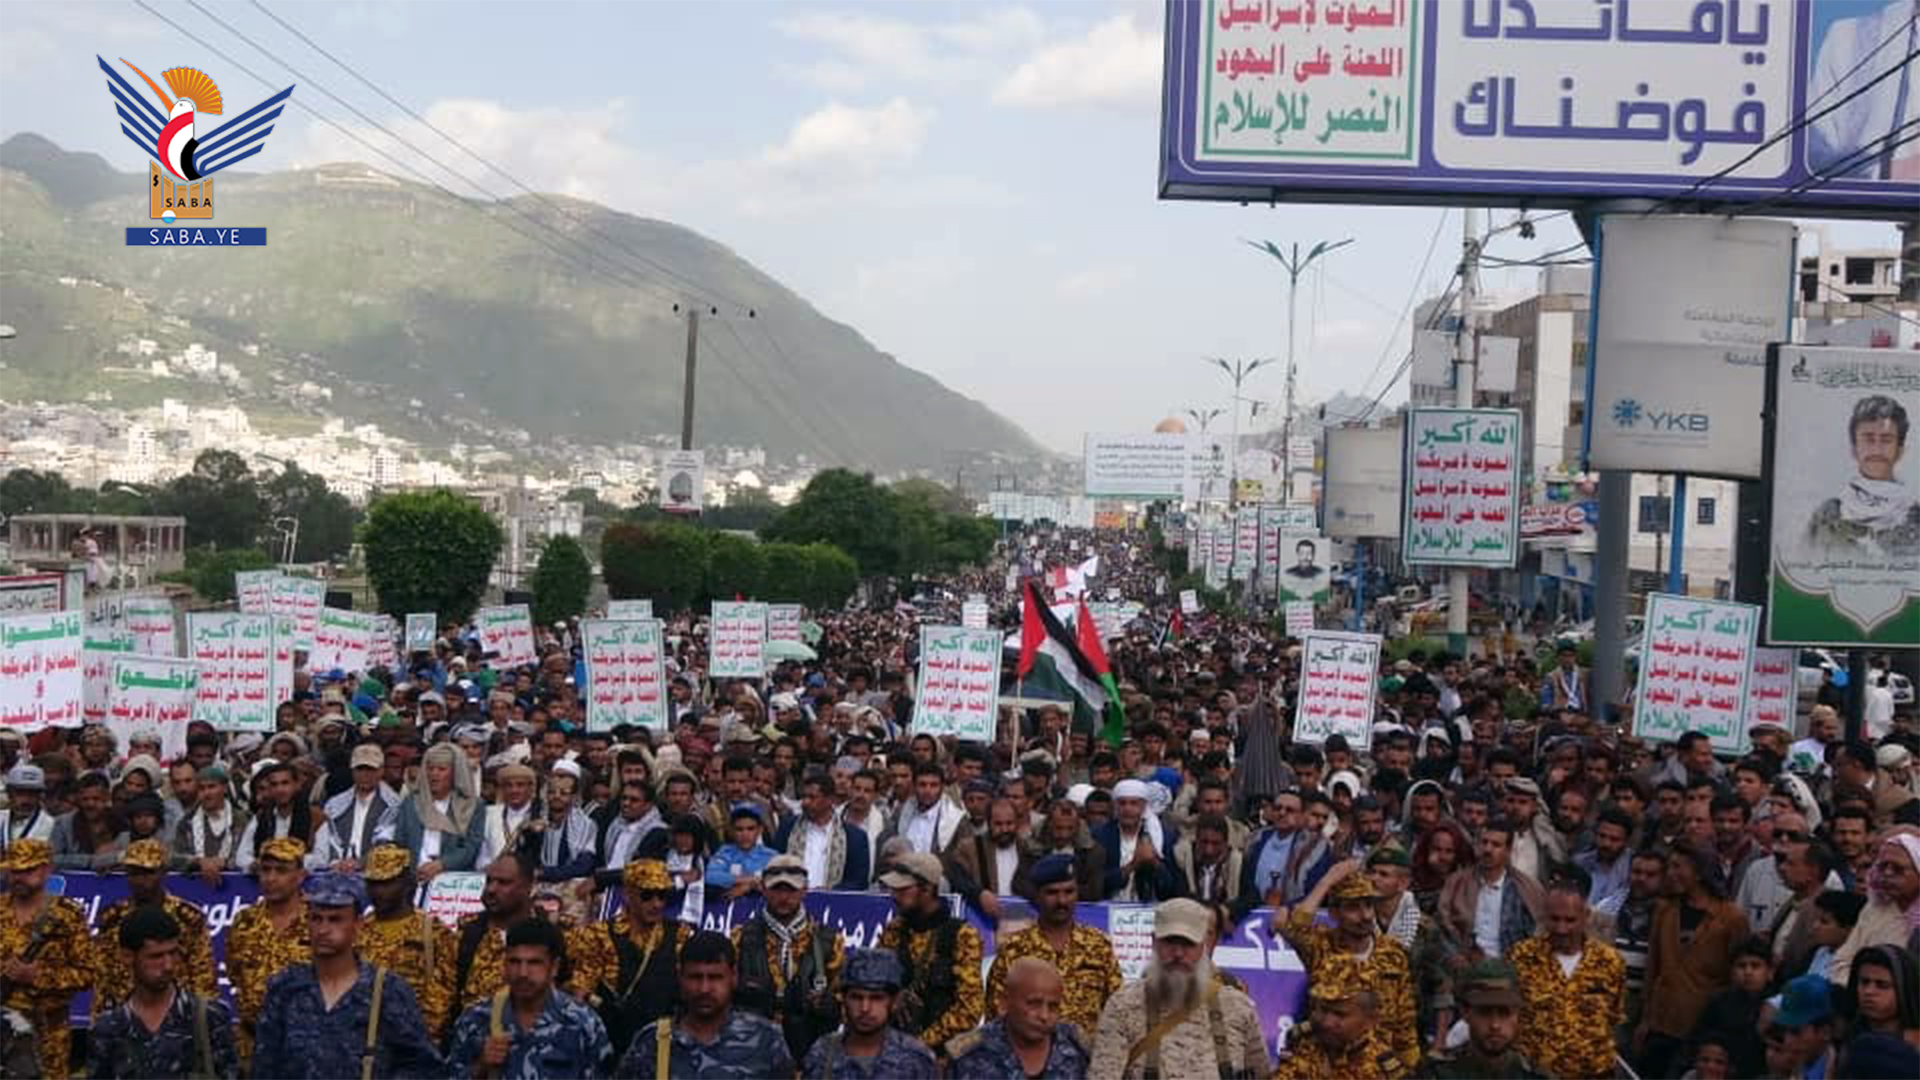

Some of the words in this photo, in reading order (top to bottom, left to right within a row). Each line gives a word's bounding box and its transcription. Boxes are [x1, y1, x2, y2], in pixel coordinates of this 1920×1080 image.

[1216, 43, 1285, 81] اليهود
[1294, 46, 1332, 84] على
[1343, 44, 1403, 78] اللعنة
[1215, 88, 1309, 145] للإسلام
[1316, 88, 1400, 144] النصر
[1454, 76, 1766, 166] فوضناك
[1480, 420, 1514, 445] الله
[1646, 412, 1709, 431] YKB
[1, 613, 80, 649] قاطعوا
[1713, 612, 1749, 635] الله
[116, 663, 198, 691] قاطعوا
